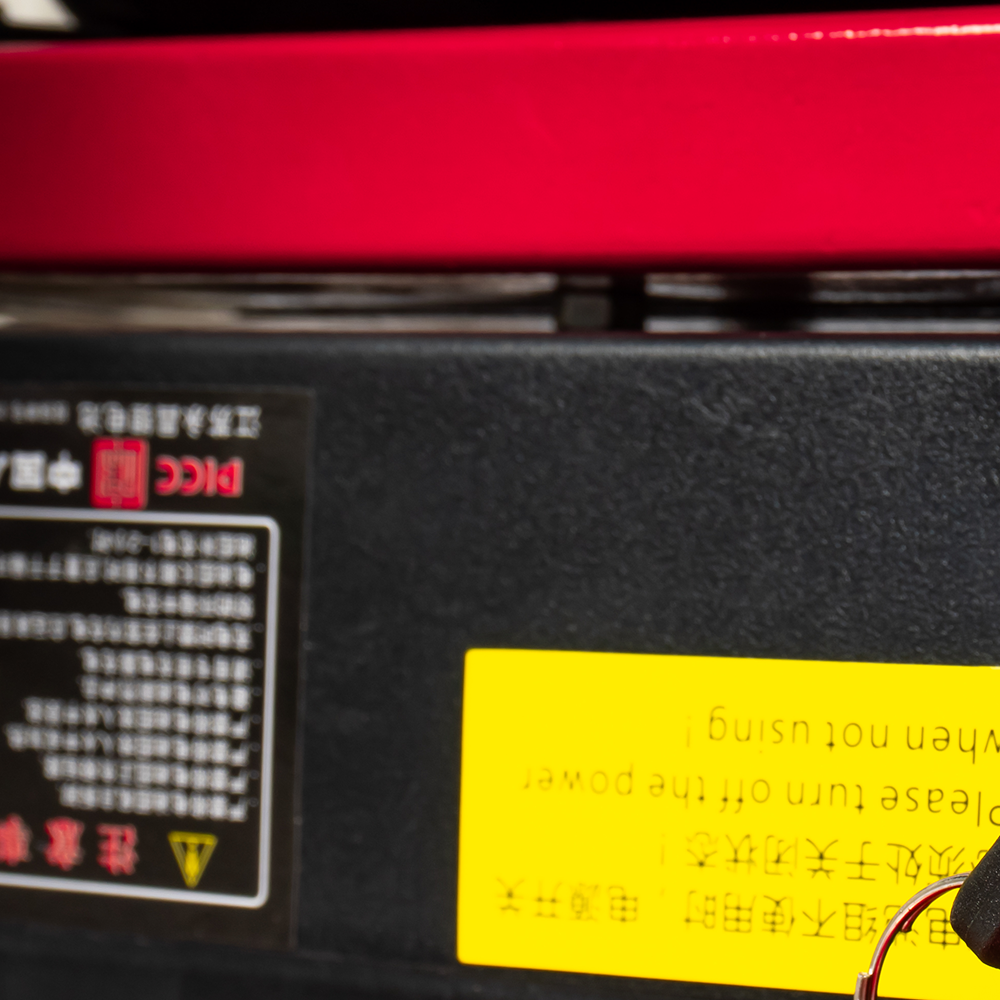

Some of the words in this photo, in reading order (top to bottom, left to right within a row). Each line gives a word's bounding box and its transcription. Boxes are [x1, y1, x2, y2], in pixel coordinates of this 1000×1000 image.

[0, 449, 83, 494] 中国
[154, 454, 243, 497] PICC
[825, 721, 889, 752] not
[522, 761, 634, 795] power
[649, 772, 705, 809] the
[718, 777, 771, 813] off
[786, 780, 863, 814] turn
